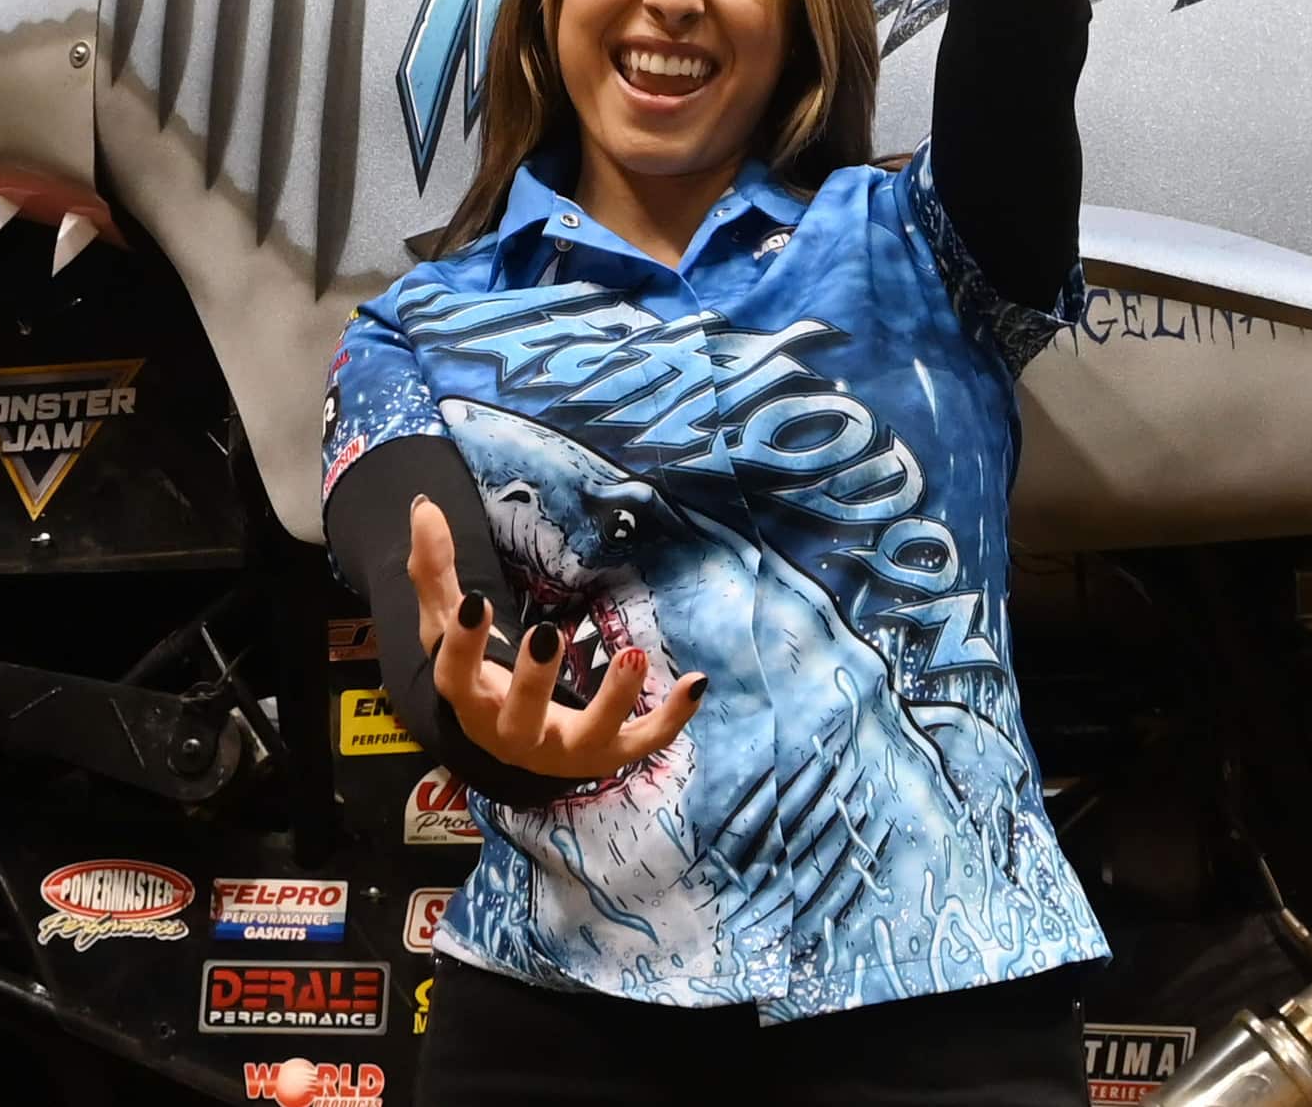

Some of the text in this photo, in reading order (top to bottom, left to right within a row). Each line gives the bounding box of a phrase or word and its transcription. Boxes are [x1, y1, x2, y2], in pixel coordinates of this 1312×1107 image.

[1, 421, 85, 453] JAM
[59, 868, 175, 913] POWERMASTER
[215, 884, 341, 907] FEL-PRO
[222, 910, 331, 926] PERFORMANCE
[242, 925, 307, 942] GASKETS
[210, 968, 381, 1012] DERALE
[208, 1011, 378, 1027] PERFORMANCE
[1084, 1039, 1177, 1078] TIMA
